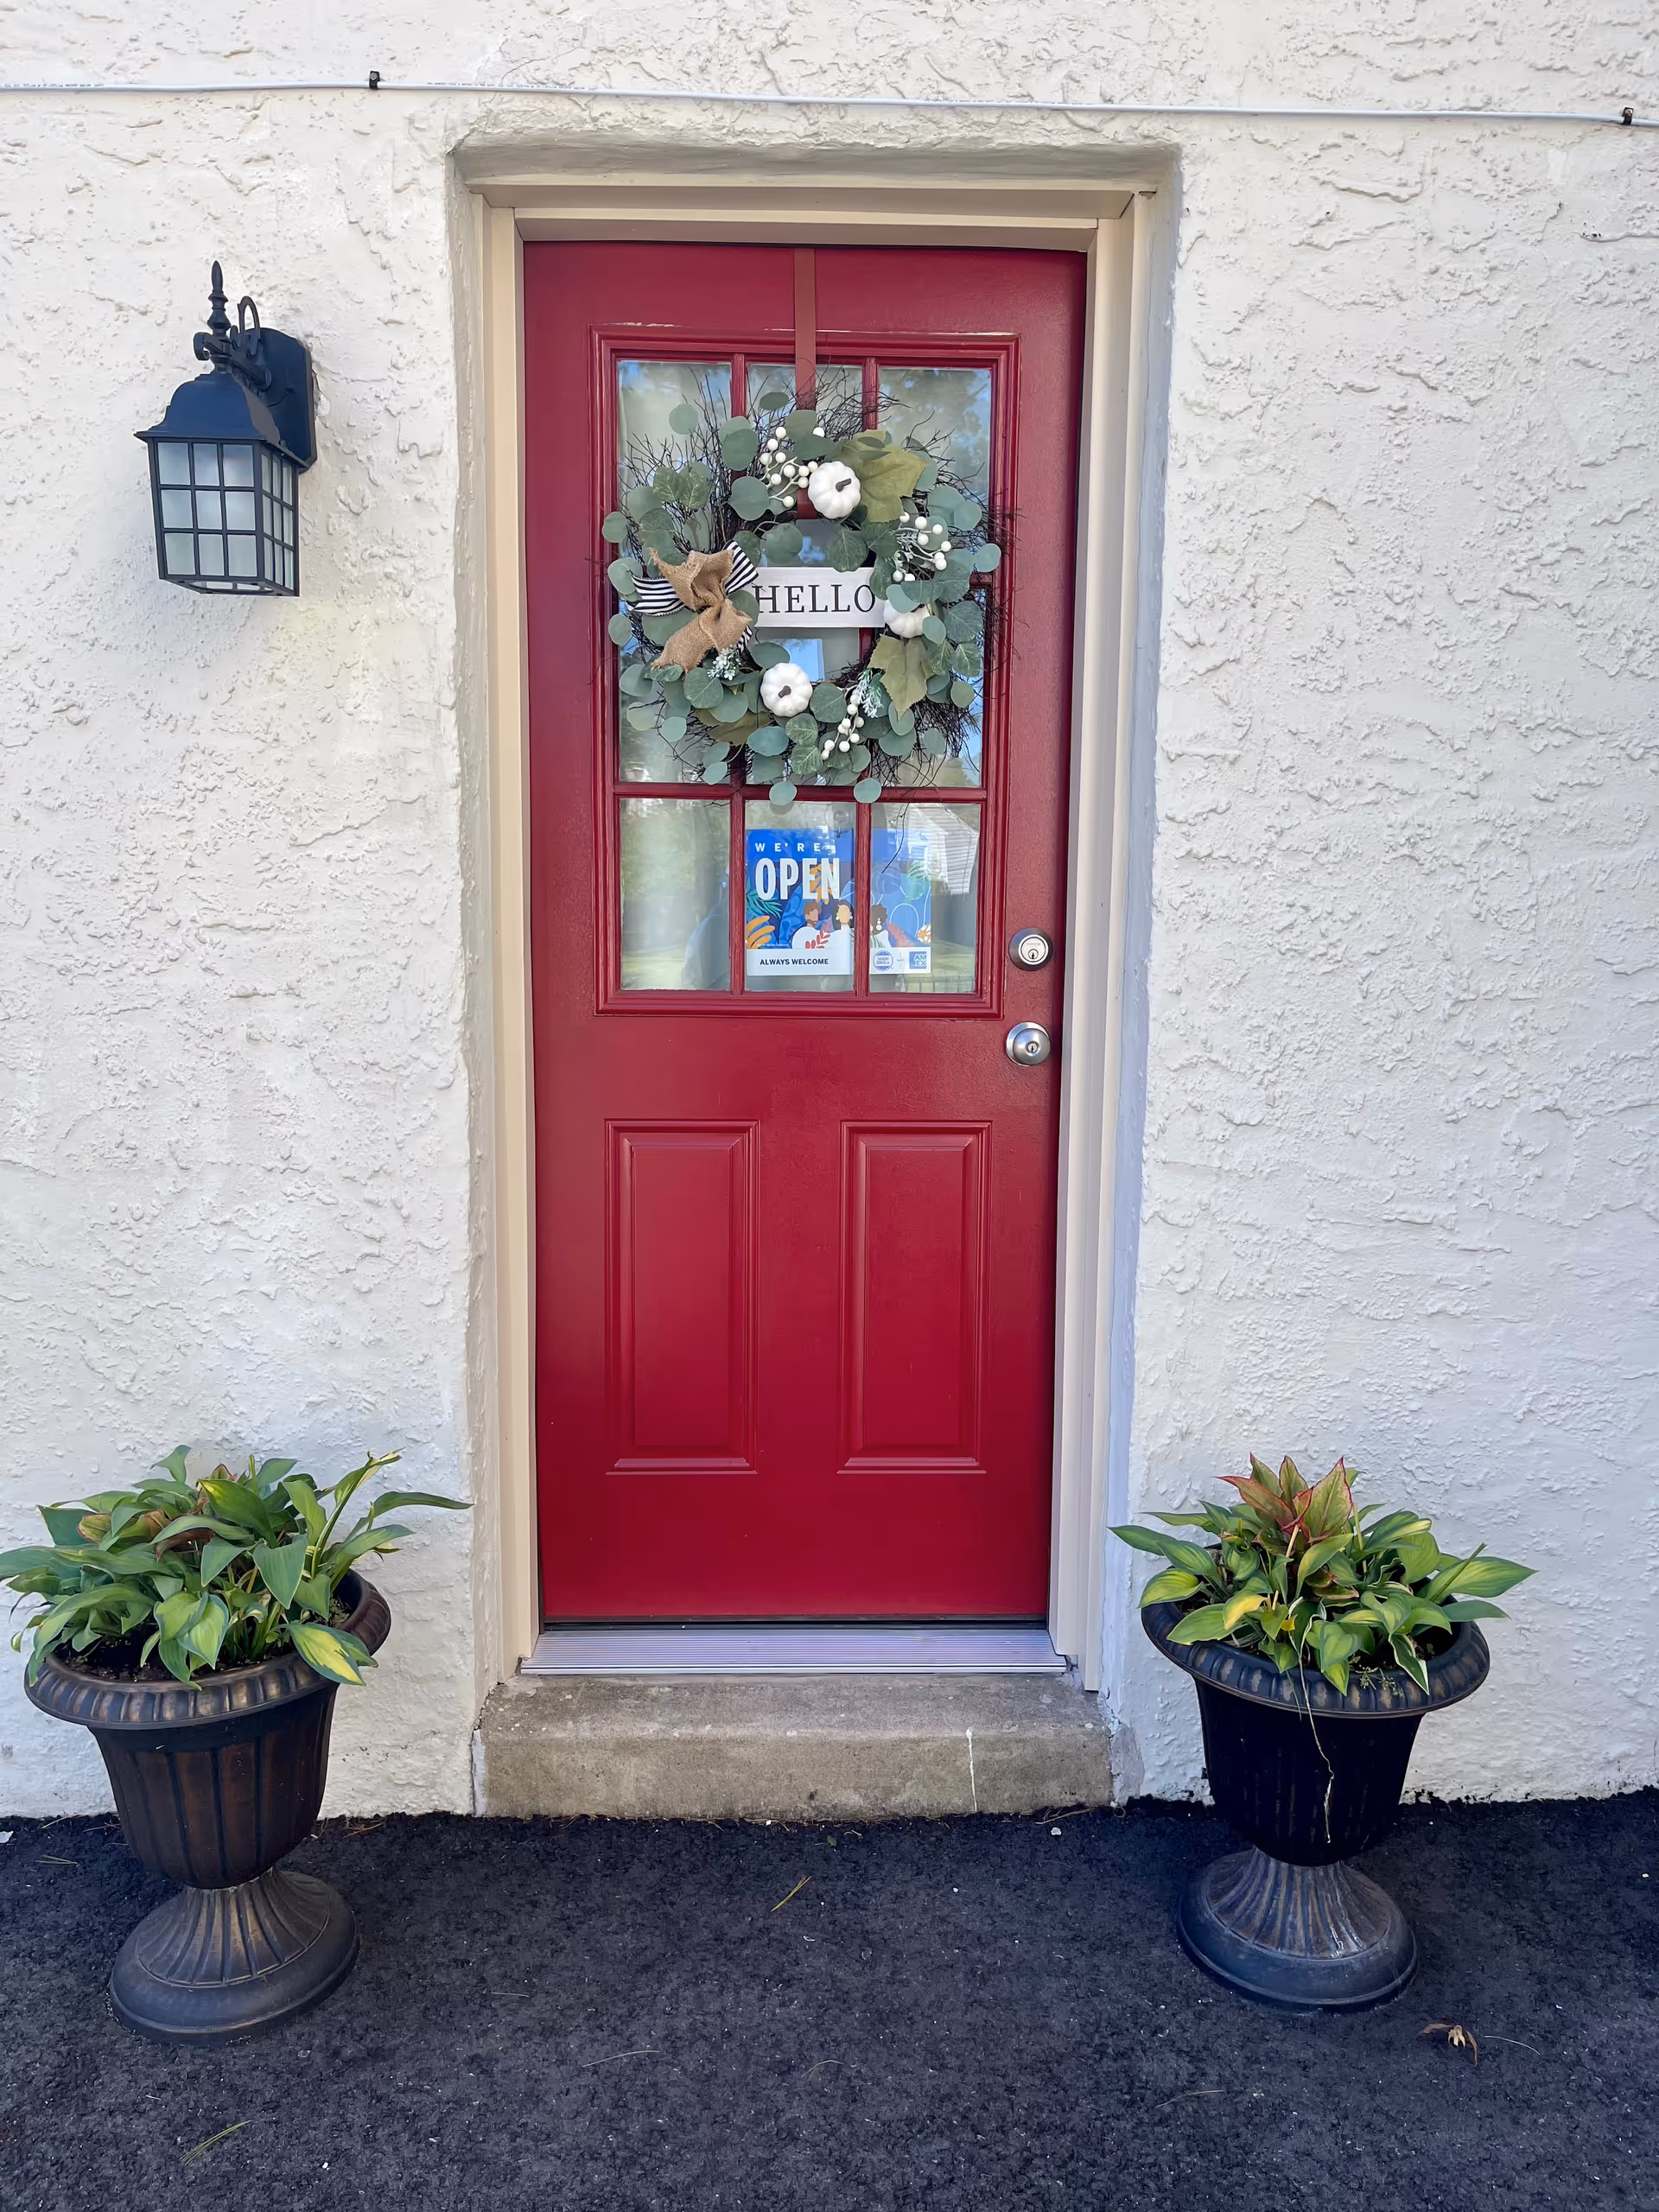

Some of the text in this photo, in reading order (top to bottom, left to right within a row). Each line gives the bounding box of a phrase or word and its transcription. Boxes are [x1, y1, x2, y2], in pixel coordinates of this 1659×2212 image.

[752, 584, 876, 613] HELLO
[754, 842, 821, 852] WE'RE
[755, 857, 840, 900] OPEN
